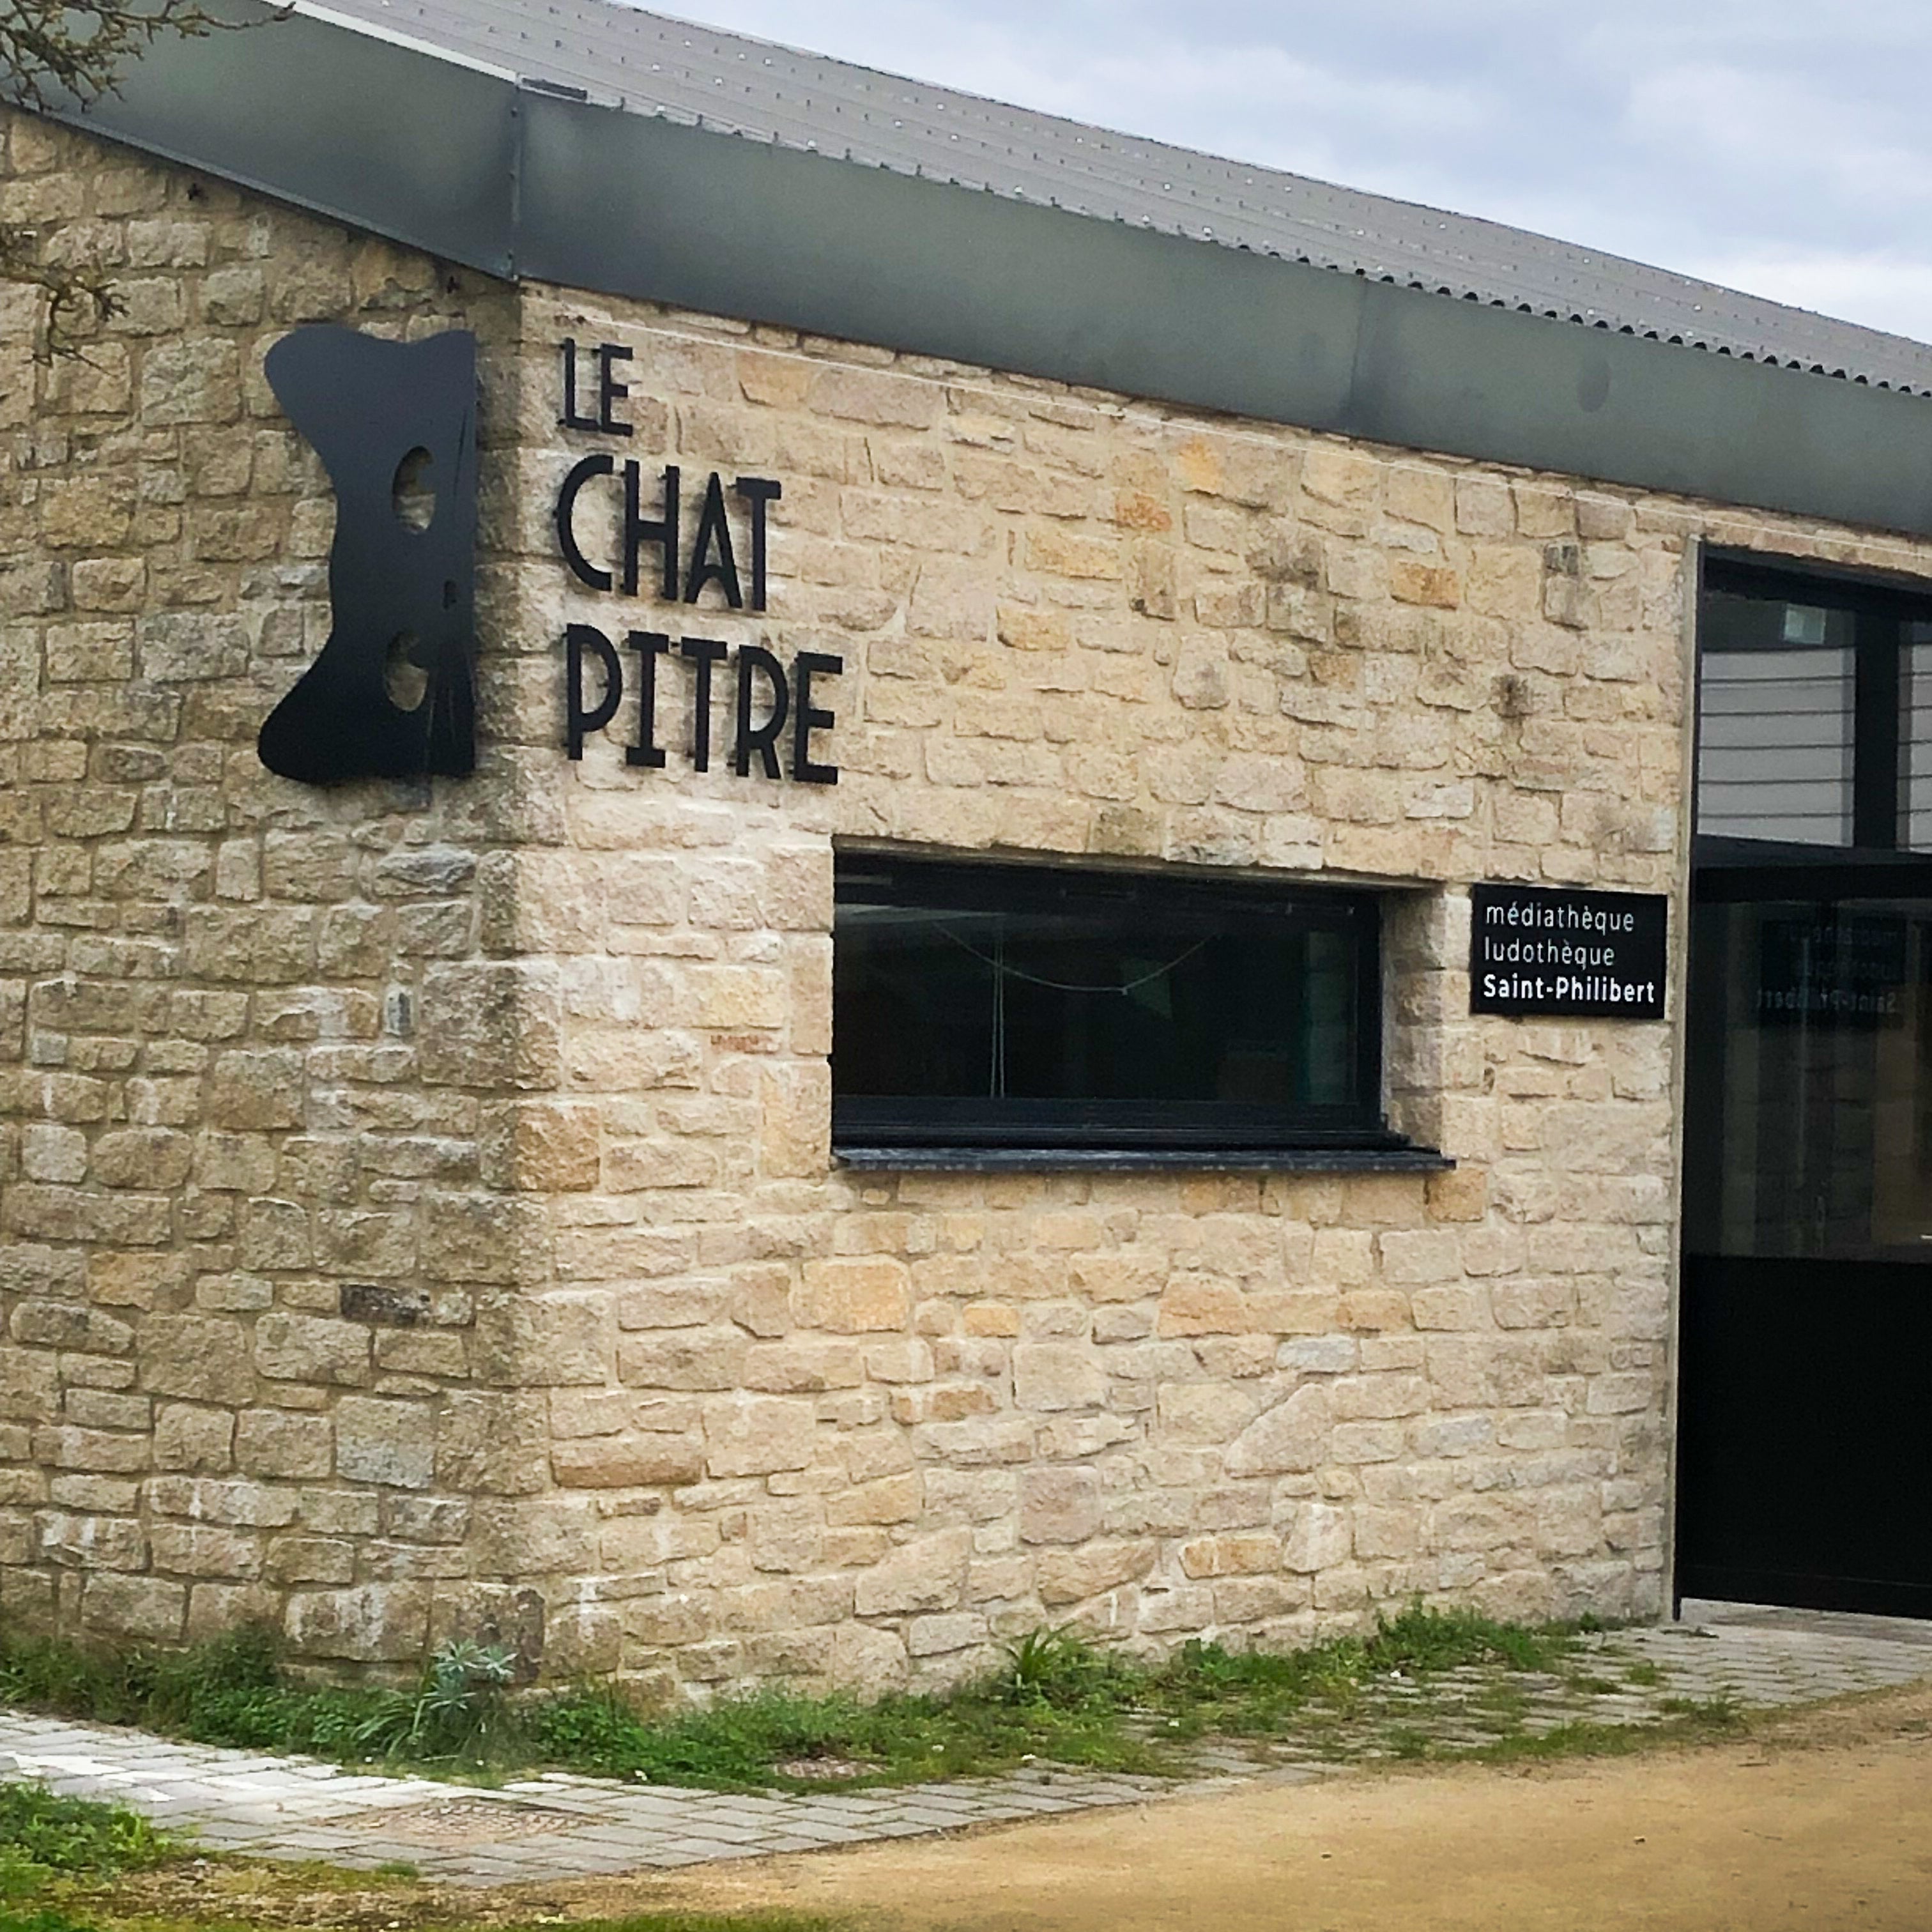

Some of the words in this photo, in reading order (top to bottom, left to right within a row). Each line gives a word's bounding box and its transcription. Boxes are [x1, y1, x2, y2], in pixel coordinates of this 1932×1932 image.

[565, 339, 633, 436] LE
[558, 456, 781, 611] CHAT
[566, 624, 843, 784] PITRE
[1486, 901, 1634, 935] médiathèque
[1485, 937, 1615, 970] ludothèque
[1483, 972, 1654, 1003] Saint-Philibert
